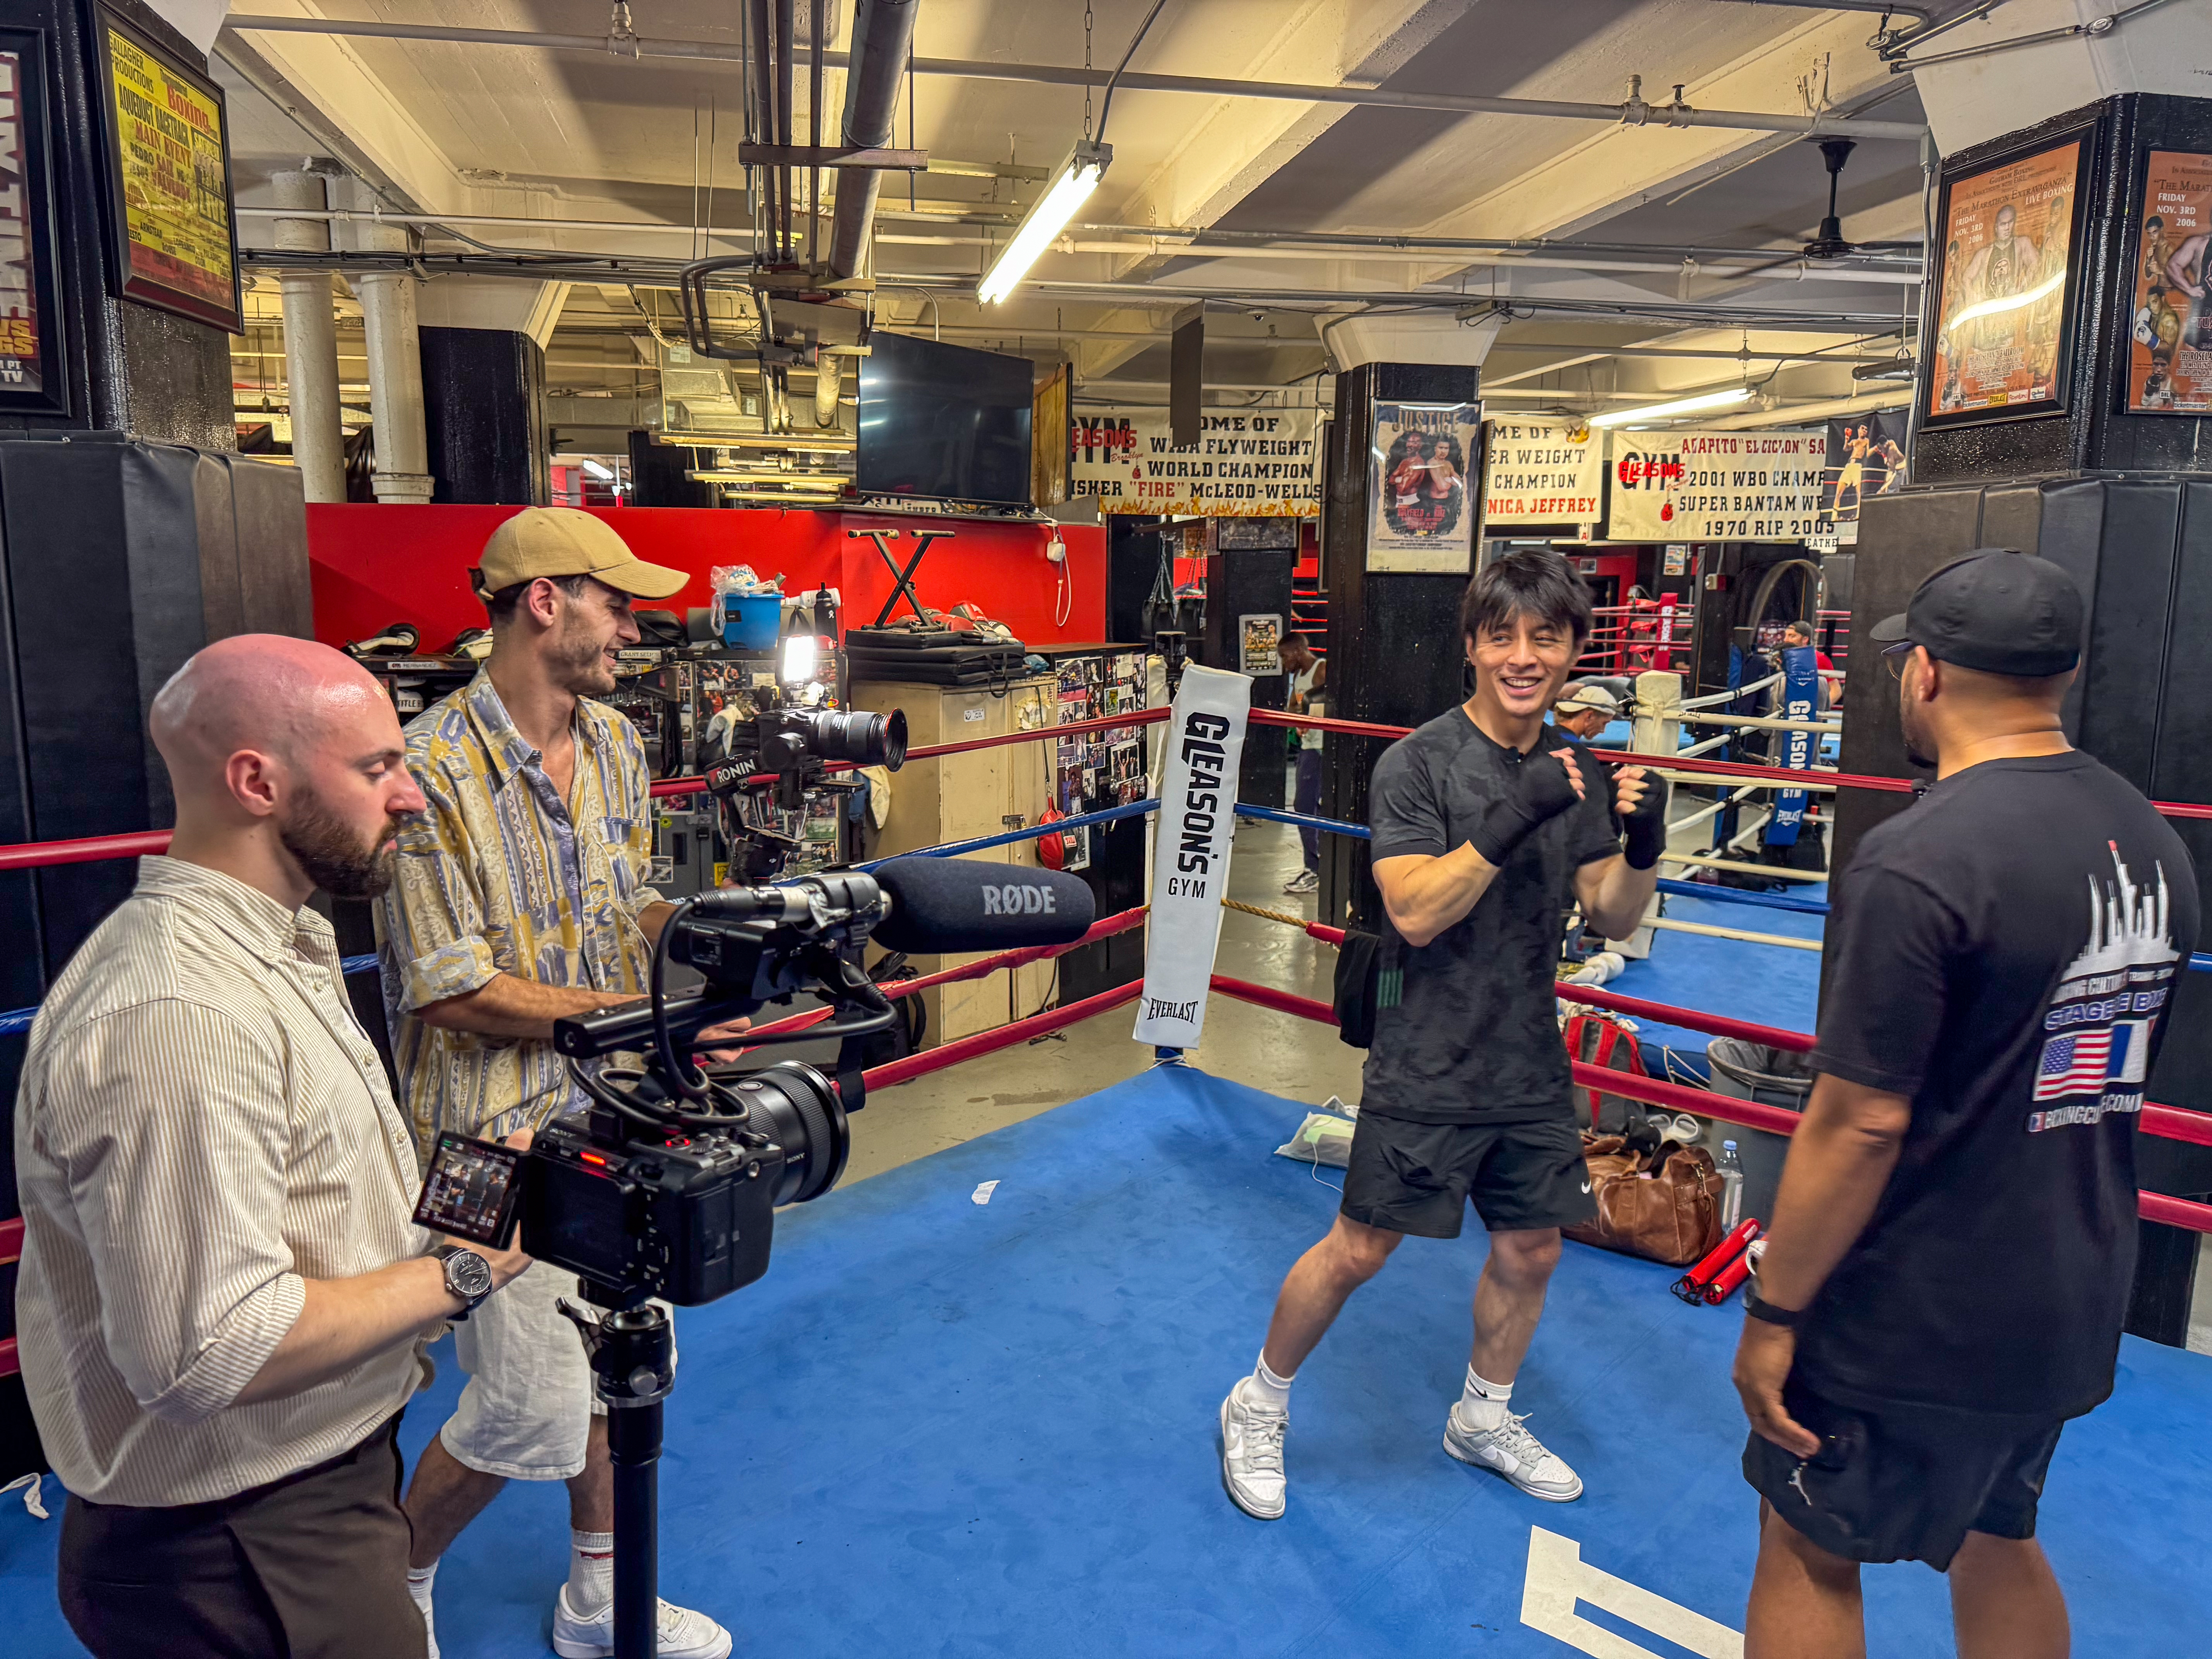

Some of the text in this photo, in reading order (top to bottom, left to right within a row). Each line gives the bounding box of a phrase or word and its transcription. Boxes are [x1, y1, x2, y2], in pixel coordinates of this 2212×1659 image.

[134, 118, 161, 151] MAIN
[130, 141, 154, 166] PEDRO
[2025, 183, 2074, 205] LIVE BOXING
[2158, 192, 2186, 202] FRIDAY
[2157, 204, 2196, 215] NOV. 3RD
[1956, 214, 1977, 227] FRIDAY
[2176, 218, 2196, 227] 2006
[1954, 223, 1983, 237] NOV. 3RD
[1968, 234, 1983, 244] 2006
[7, 361, 21, 369] PT
[1, 371, 23, 383] TV
[1200, 417, 1279, 432] OME OF
[1072, 425, 1137, 452] EASON'S
[1530, 427, 1552, 439] OF
[1206, 438, 1312, 456] FLYWEIGHT
[1490, 449, 1585, 464] ER WEIGHT
[1147, 461, 1314, 479] WORLD CHAMPION
[1494, 474, 1577, 489] CHAMPION
[1689, 471, 1726, 487] 2001
[1733, 471, 1767, 487] WBO
[1072, 480, 1123, 496] ISHER
[1487, 498, 1597, 514] NICA JEFFREY
[1679, 496, 1728, 512] SUPER
[1733, 496, 1797, 511] BANTAM
[1705, 520, 1747, 536] 1970
[1754, 520, 1783, 535] RIP
[716, 759, 756, 783] RONIN
[1178, 711, 1230, 875] GLEASON'S
[1783, 788, 1802, 798] GYM
[1168, 877, 1205, 899] GYM
[1146, 998, 1198, 1024] EVERLAST
[787, 1152, 805, 1164] SONY
